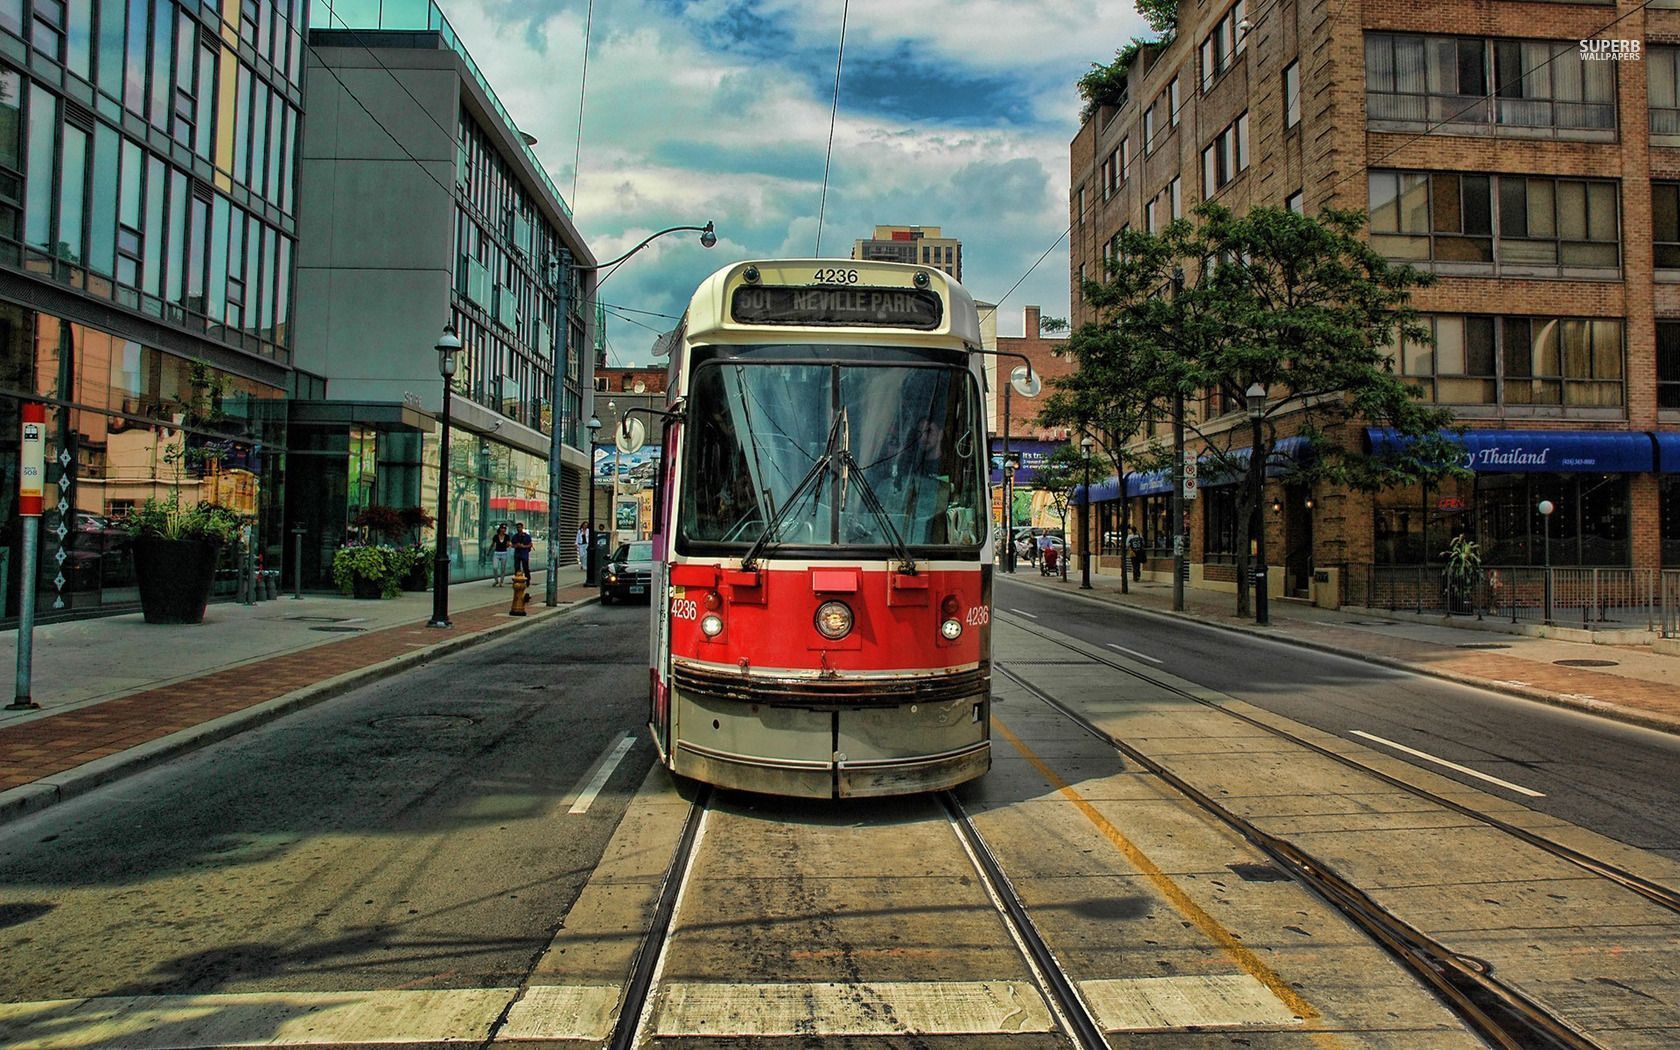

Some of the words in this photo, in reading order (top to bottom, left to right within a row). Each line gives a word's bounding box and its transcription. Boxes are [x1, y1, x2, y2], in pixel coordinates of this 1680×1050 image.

[814, 269, 858, 284] 4236
[793, 289, 866, 312] NEVILLE
[871, 292, 919, 314] PARK
[1479, 447, 1550, 465] Thailand
[671, 599, 697, 620] 4236
[966, 605, 989, 626] 4236
